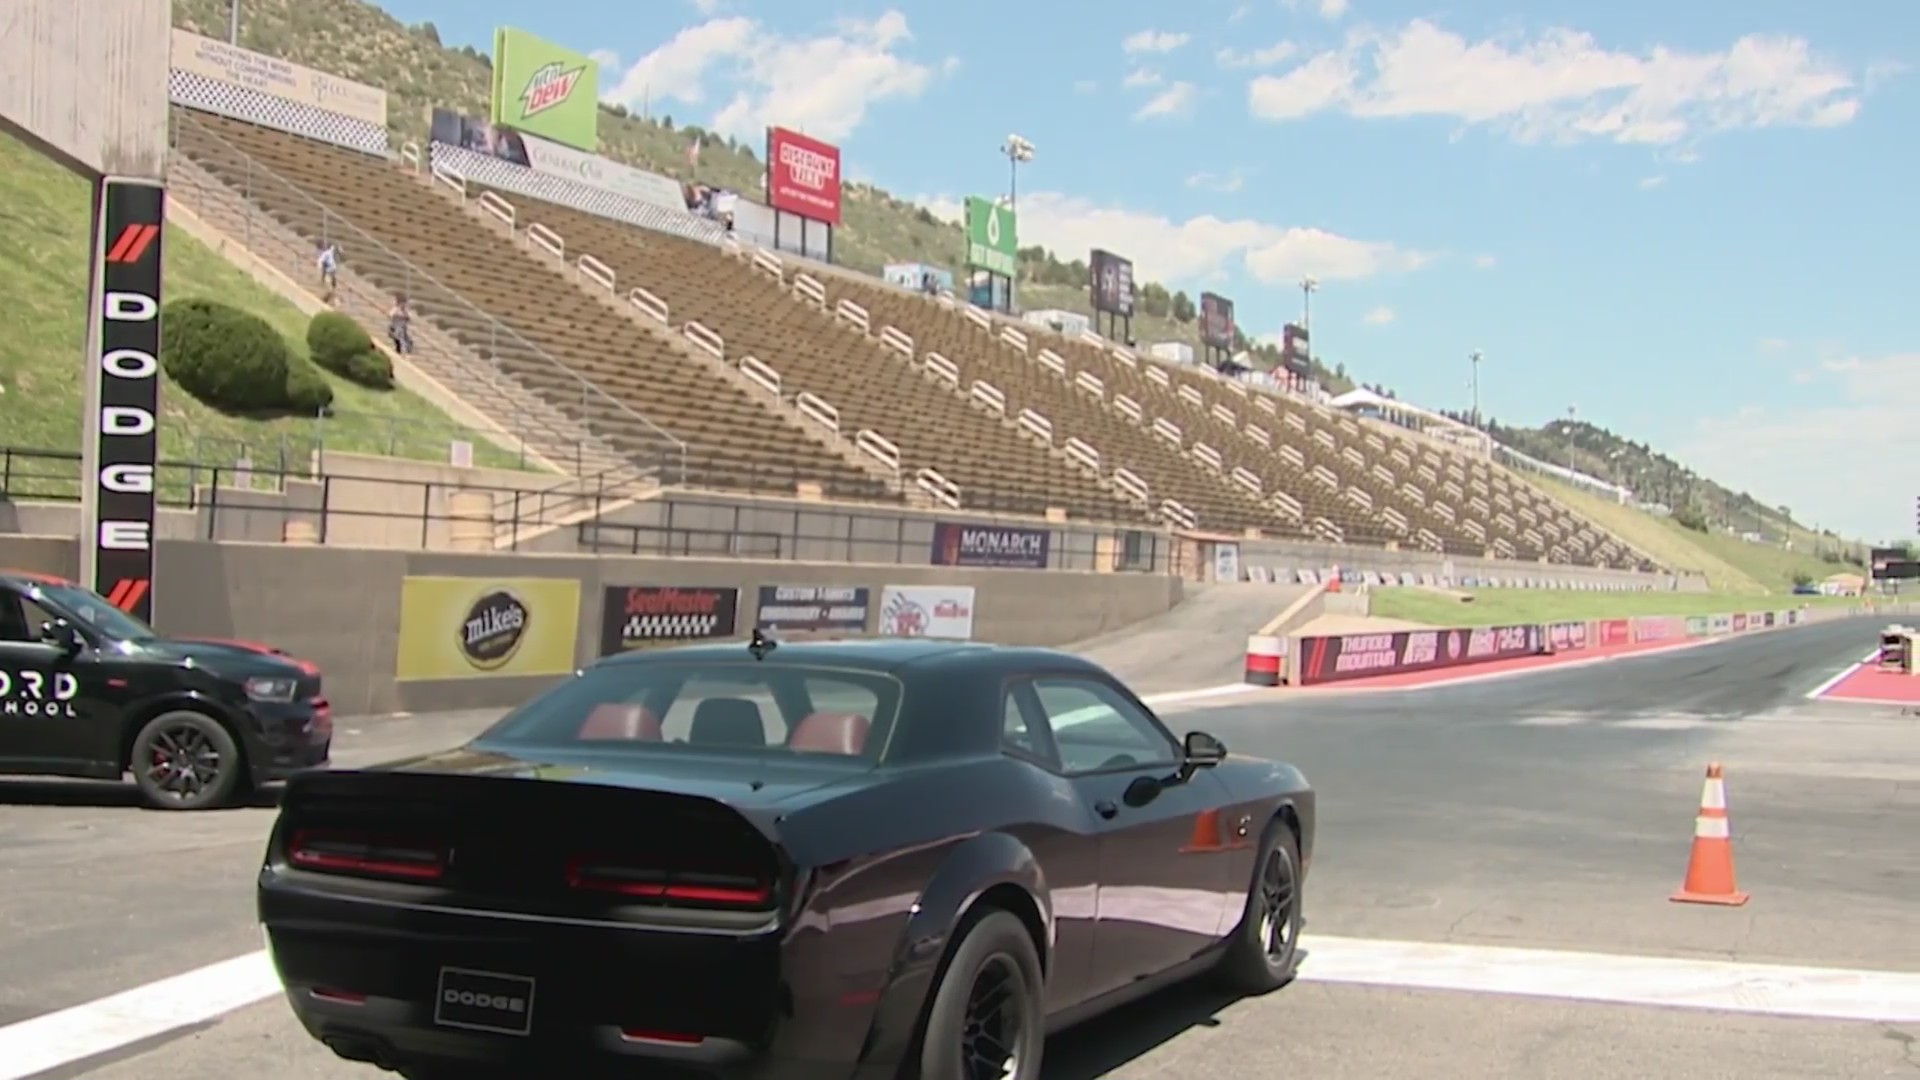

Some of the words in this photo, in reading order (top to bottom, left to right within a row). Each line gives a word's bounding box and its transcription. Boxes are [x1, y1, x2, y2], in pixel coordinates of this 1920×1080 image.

[195, 50, 233, 70] WITHOUT
[200, 40, 251, 64] CULTIVATING
[253, 55, 268, 68] THE
[101, 292, 158, 550] DODGE
[961, 530, 1042, 555] MONARCH
[466, 604, 523, 645] mike's
[1341, 634, 1393, 654] THUNDER
[1336, 650, 1396, 671] MOUNTAIN
[4, 701, 77, 718] HOOL
[444, 988, 524, 1013] DODGE
